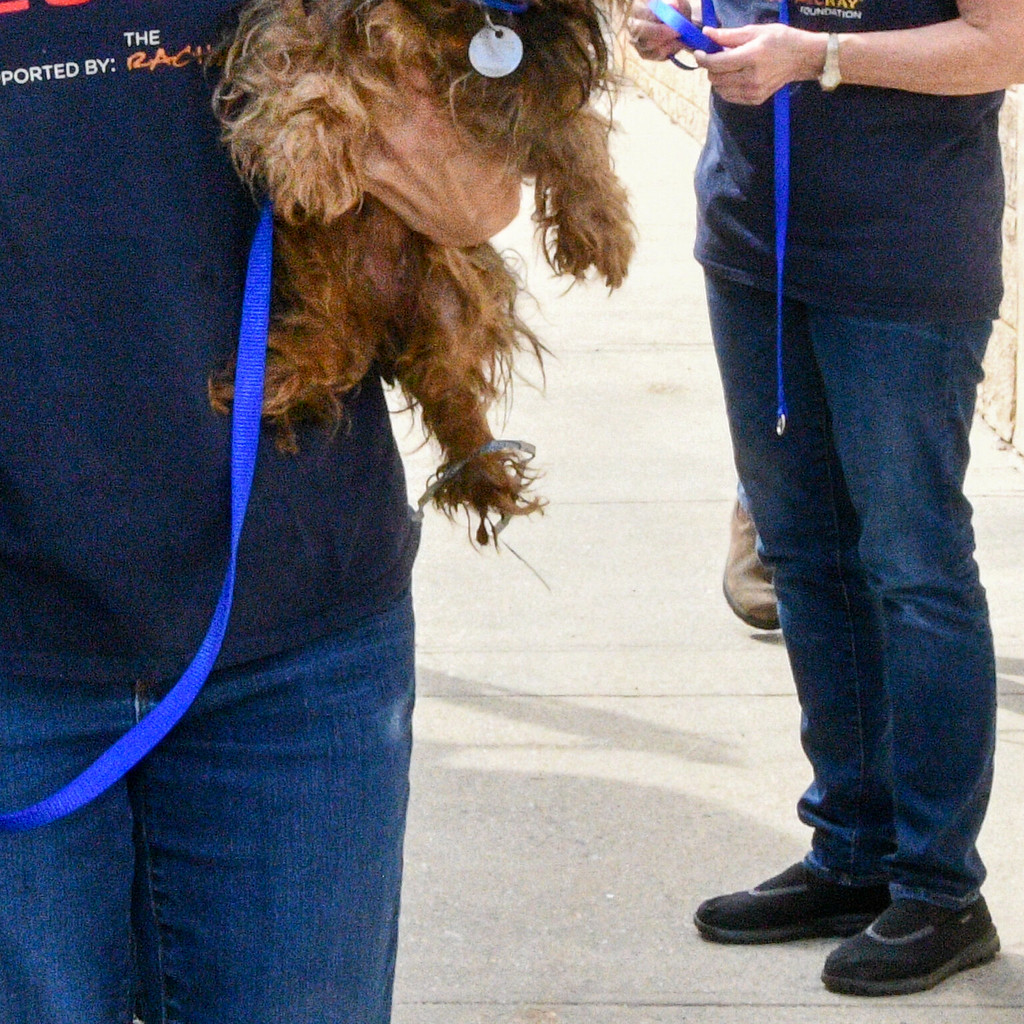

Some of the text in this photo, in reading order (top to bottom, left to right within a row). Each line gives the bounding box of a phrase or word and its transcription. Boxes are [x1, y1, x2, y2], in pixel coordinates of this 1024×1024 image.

[800, 5, 863, 19] FOUNDATION
[123, 29, 161, 47] THE
[85, 57, 117, 75] BY:
